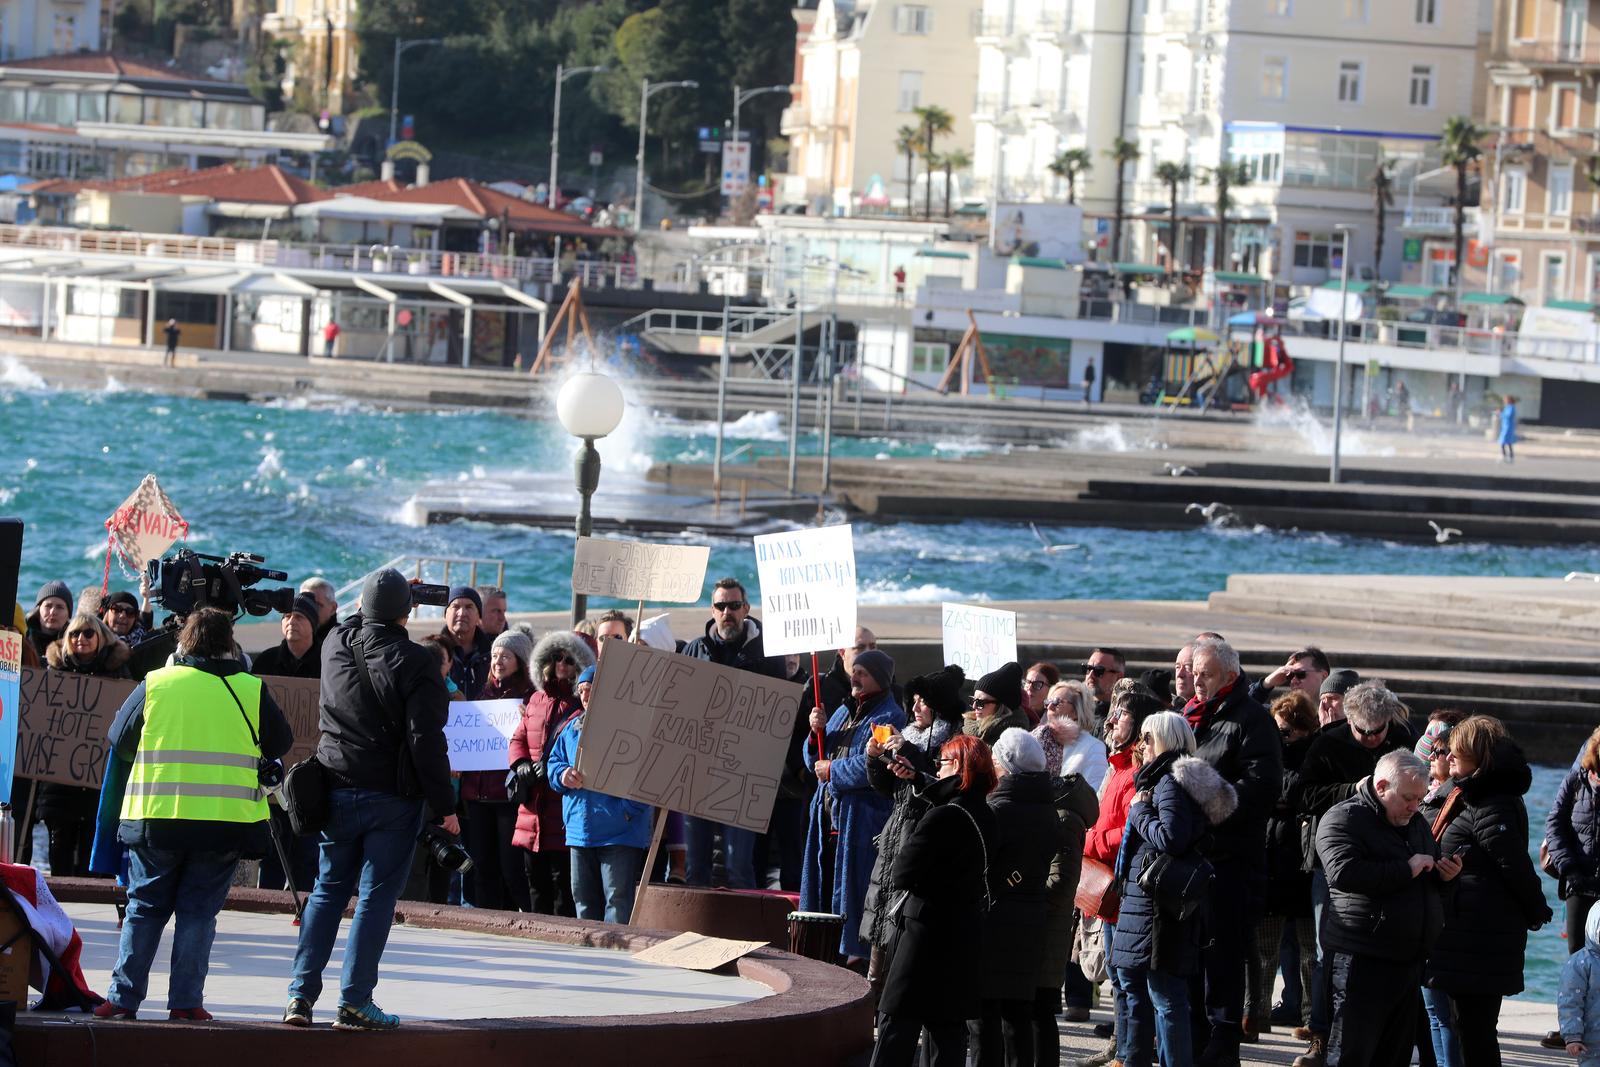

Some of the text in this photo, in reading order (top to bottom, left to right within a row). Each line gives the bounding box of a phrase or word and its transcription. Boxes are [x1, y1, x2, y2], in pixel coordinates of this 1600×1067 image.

[113, 508, 179, 541] PRIVATE
[616, 543, 683, 569] JAVNO
[759, 540, 802, 562] DANAS
[573, 562, 605, 593] JE
[769, 592, 810, 613] SUTRA
[615, 651, 799, 740] NE DAMO
[453, 738, 485, 752] SAMO
[652, 713, 740, 761] NAŠE
[593, 729, 778, 829] PLAŽE
